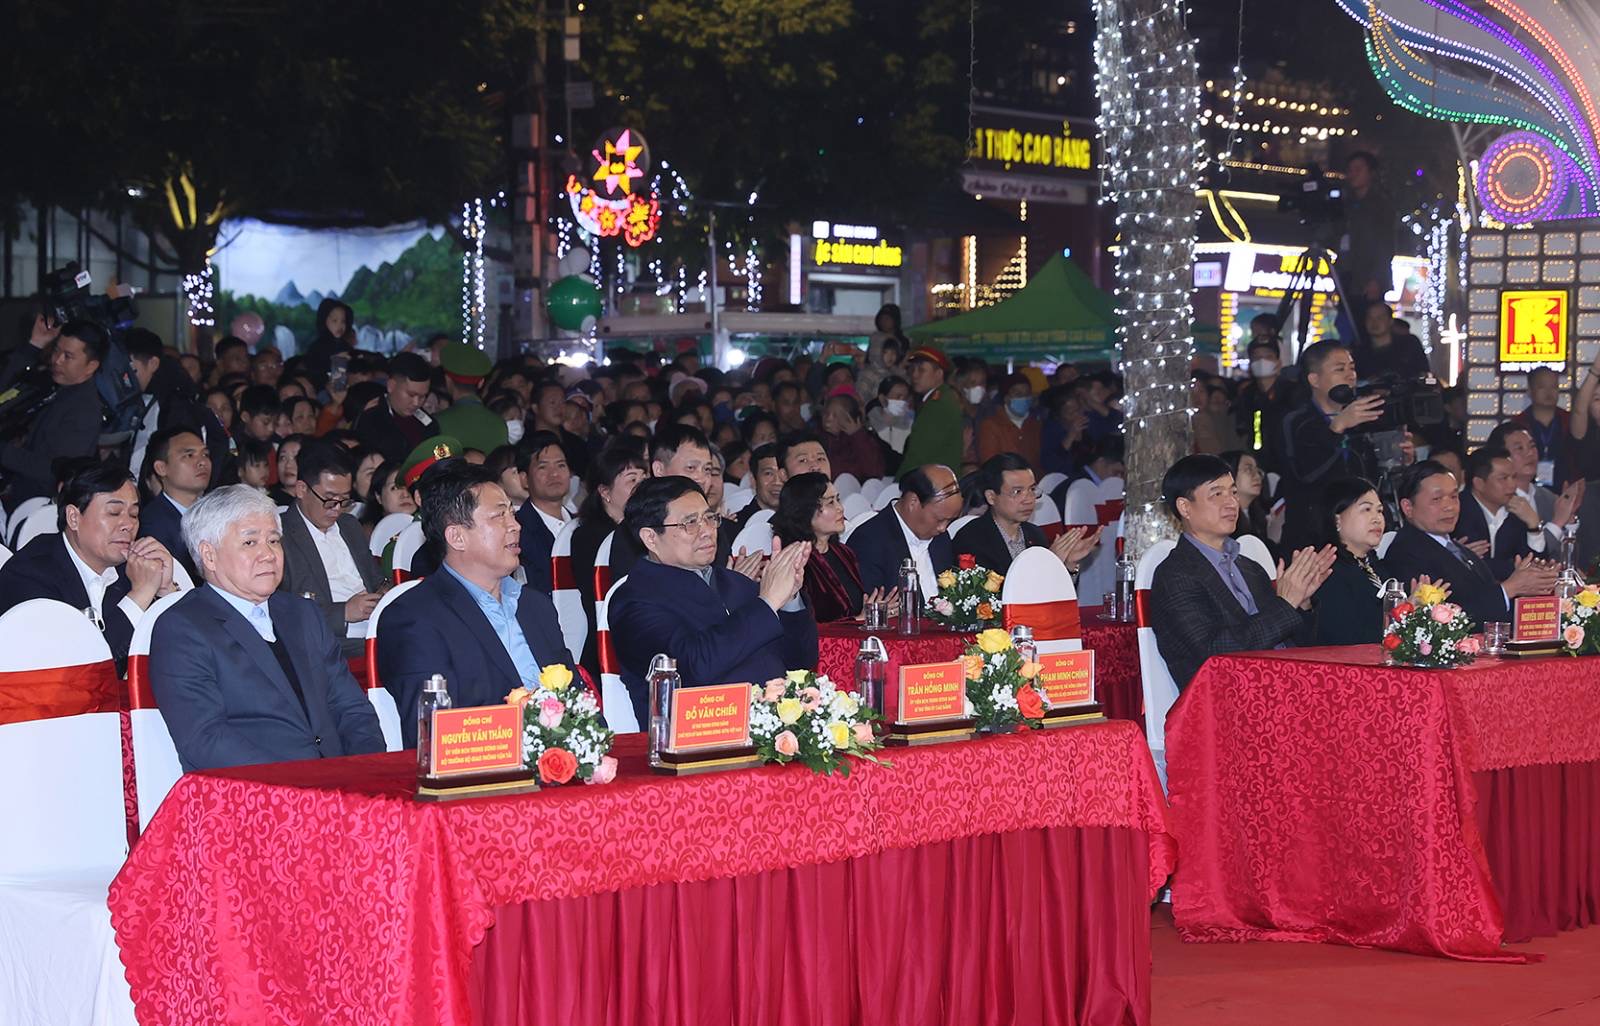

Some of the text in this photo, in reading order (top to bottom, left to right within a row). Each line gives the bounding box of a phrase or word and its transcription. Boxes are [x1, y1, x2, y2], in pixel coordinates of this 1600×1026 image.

[985, 128, 1022, 170] THỰC
[1024, 132, 1051, 165] CAO
[1054, 119, 1090, 170] BẰNG
[908, 681, 960, 695] TRẦN HỒNG MINH
[700, 694, 725, 704] ĐỒNG CHÍ
[698, 706, 714, 719] VĂN
[715, 703, 737, 717] CHIẾN
[463, 715, 492, 726] ĐỒNG CHÍ
[441, 724, 513, 745] NGUYỄN VĂN THẮNG
